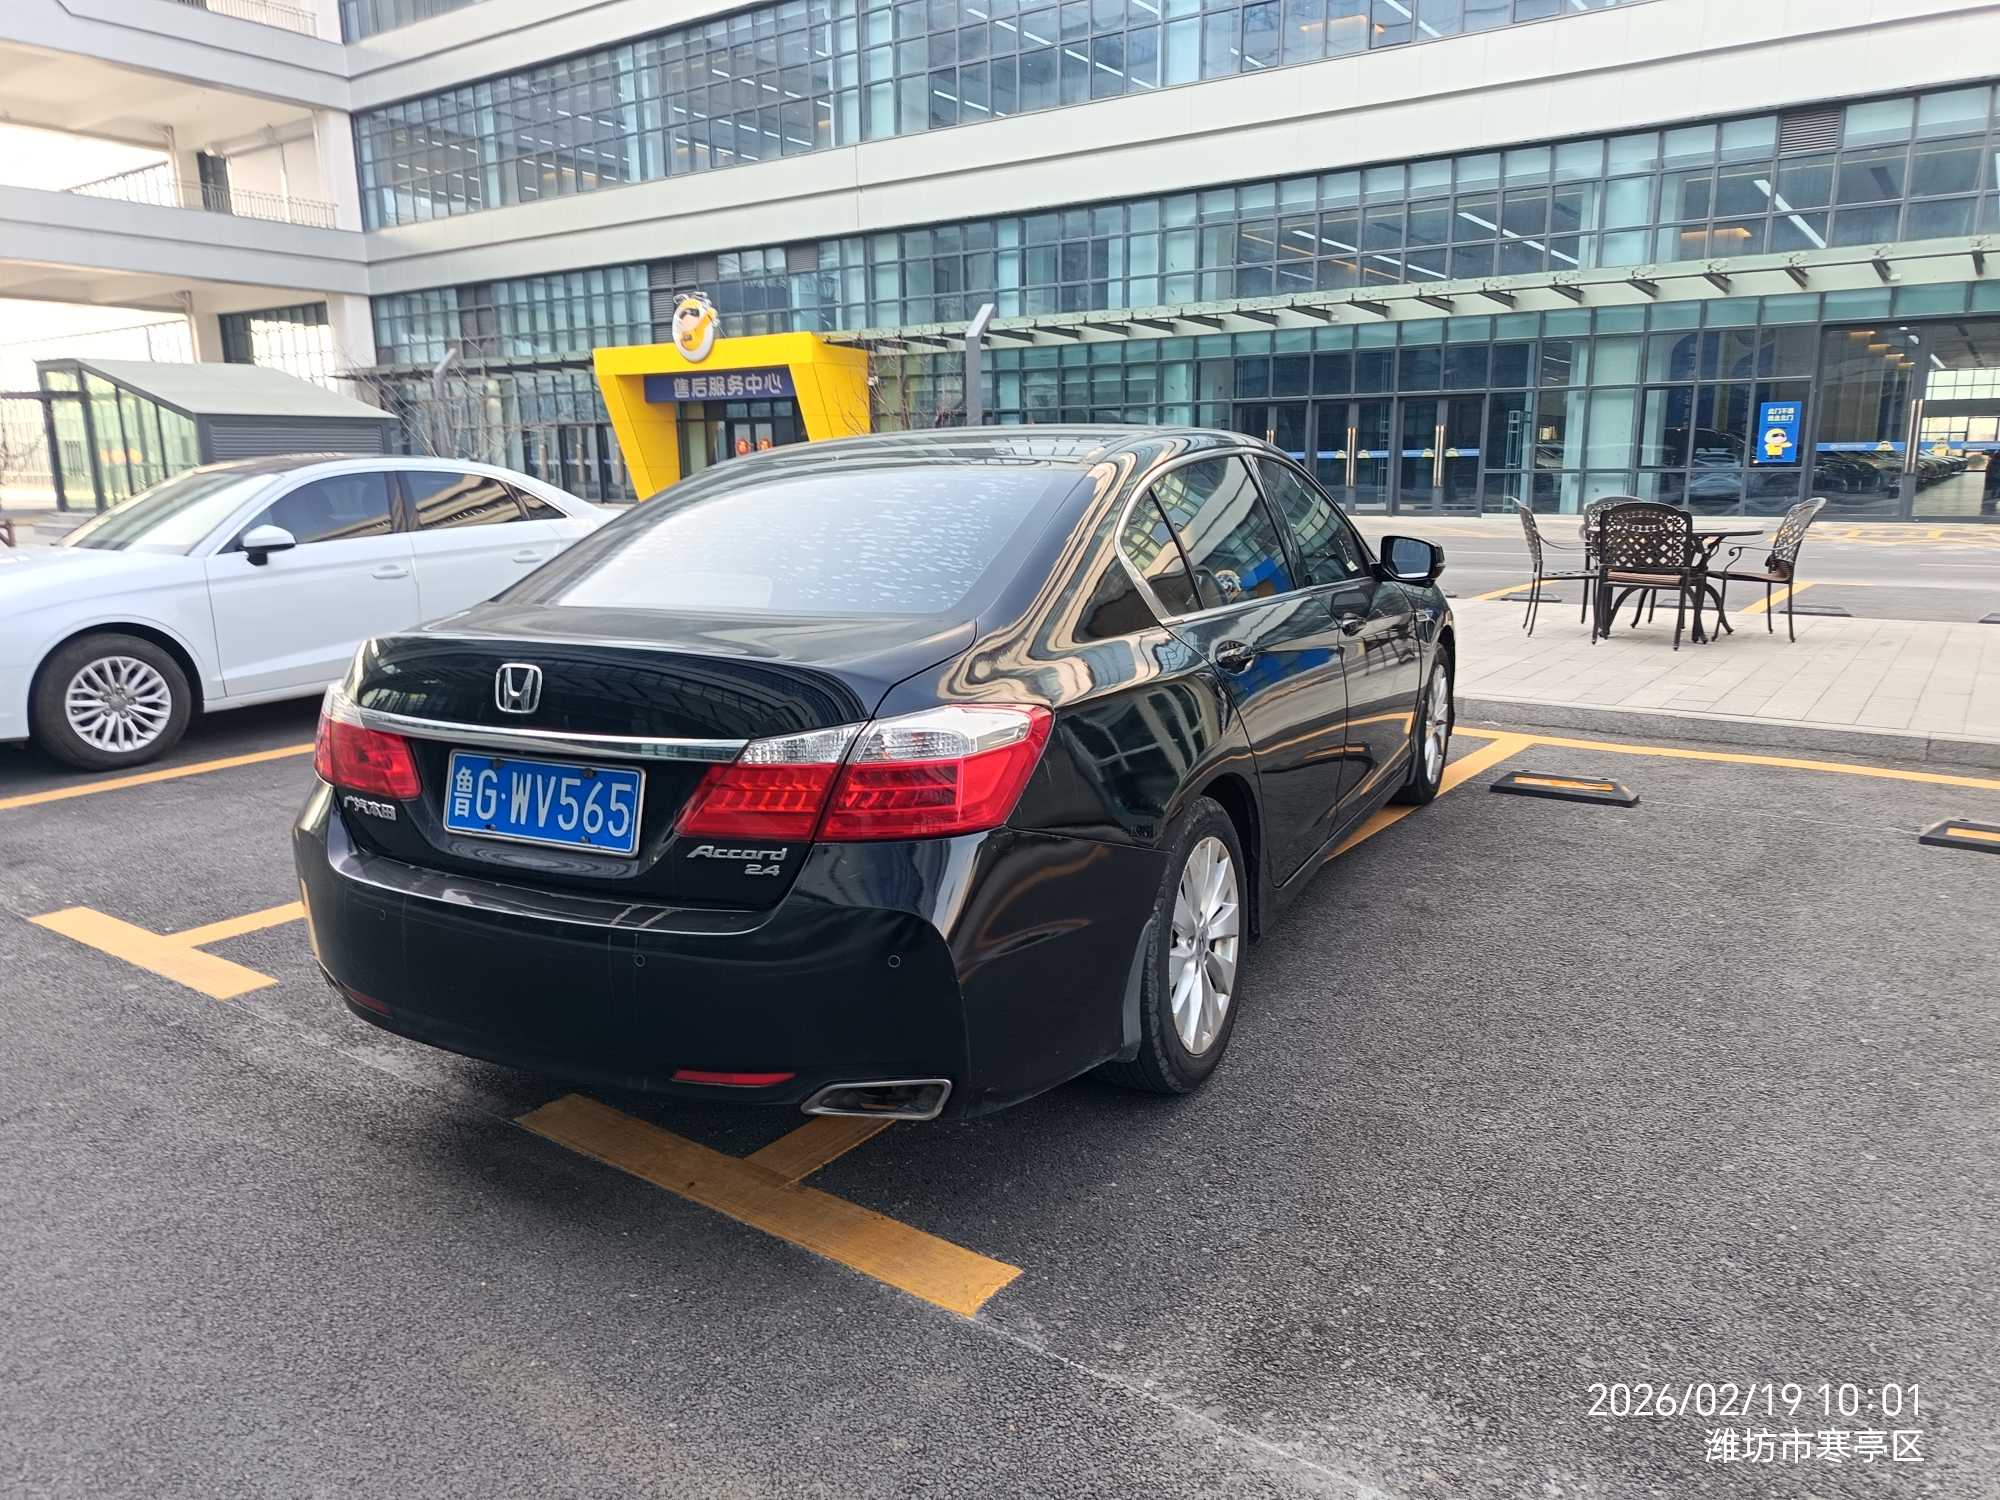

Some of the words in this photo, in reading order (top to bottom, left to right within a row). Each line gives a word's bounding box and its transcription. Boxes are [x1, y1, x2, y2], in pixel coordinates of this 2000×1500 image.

[673, 372, 782, 398] 售后服务中心
[686, 845, 788, 861] Accord
